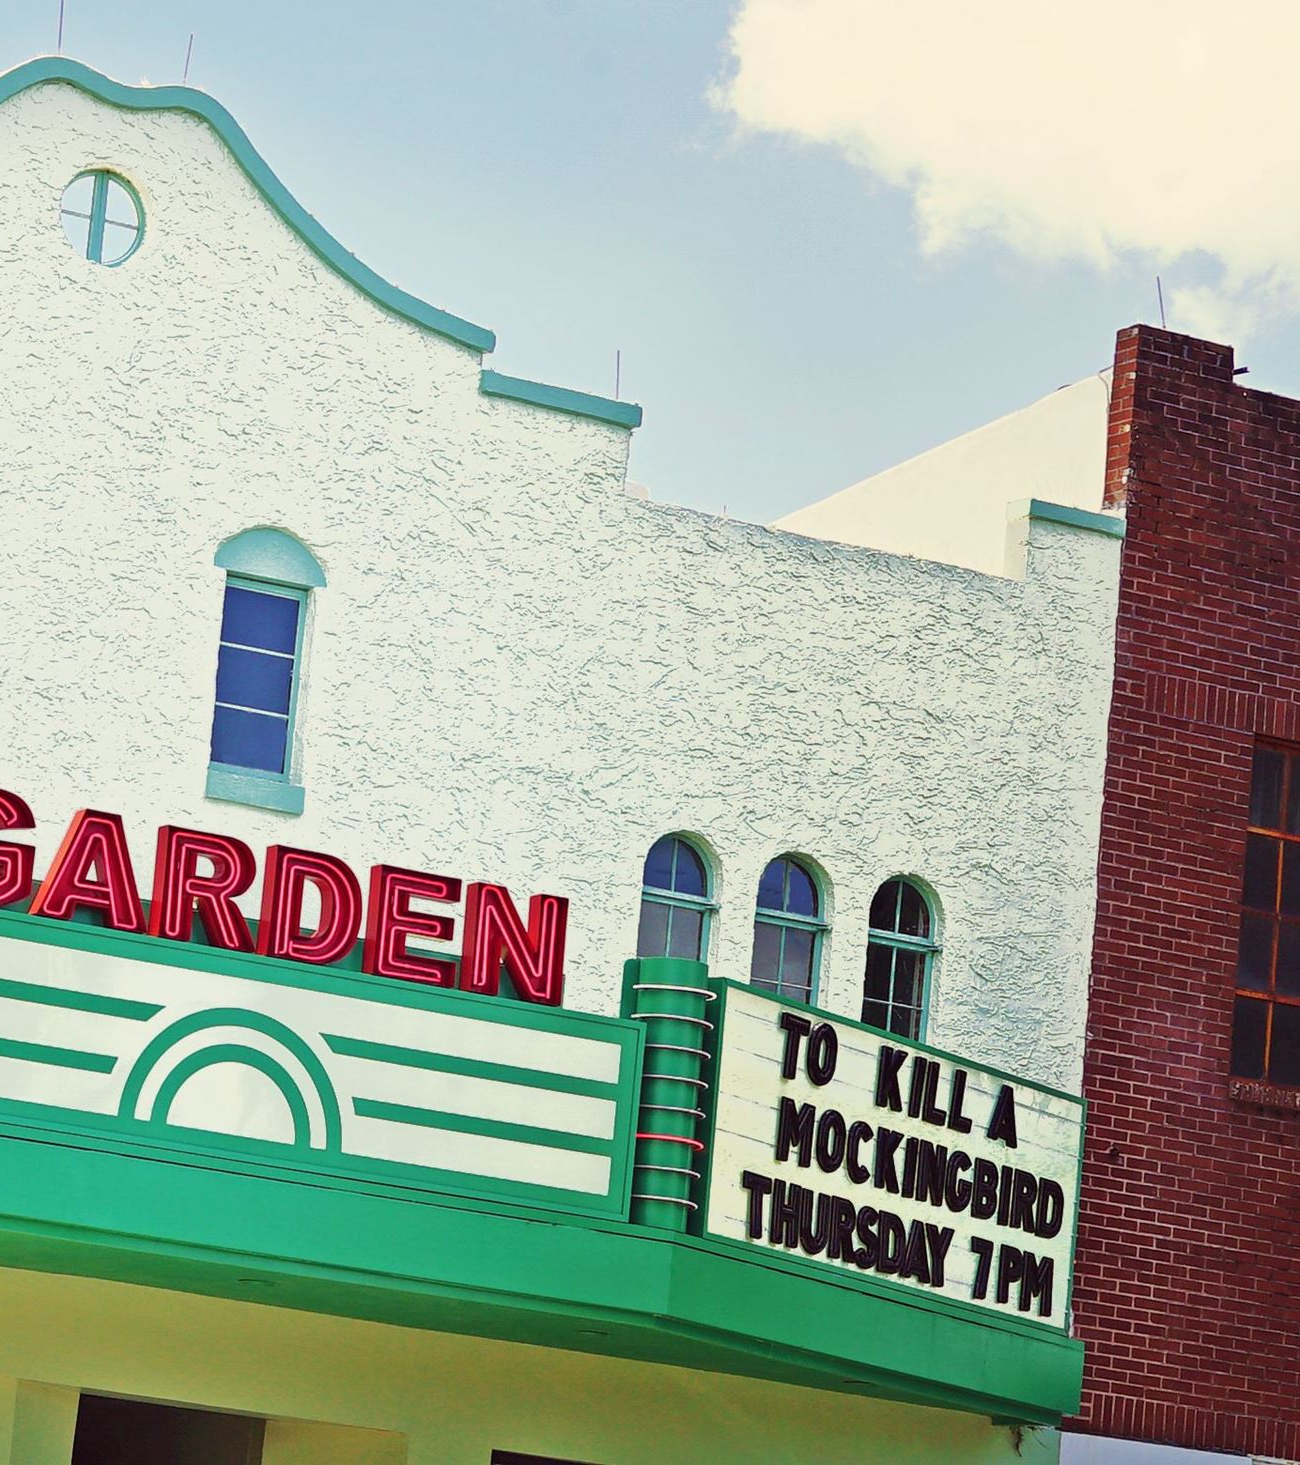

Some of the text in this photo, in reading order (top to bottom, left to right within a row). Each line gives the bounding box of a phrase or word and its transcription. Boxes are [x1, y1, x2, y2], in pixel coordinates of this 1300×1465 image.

[781, 1012, 1017, 1148] TO KILL A
[742, 1170, 954, 1287] THURSDAY
[775, 1096, 1064, 1239] MOCKINGBIRD
